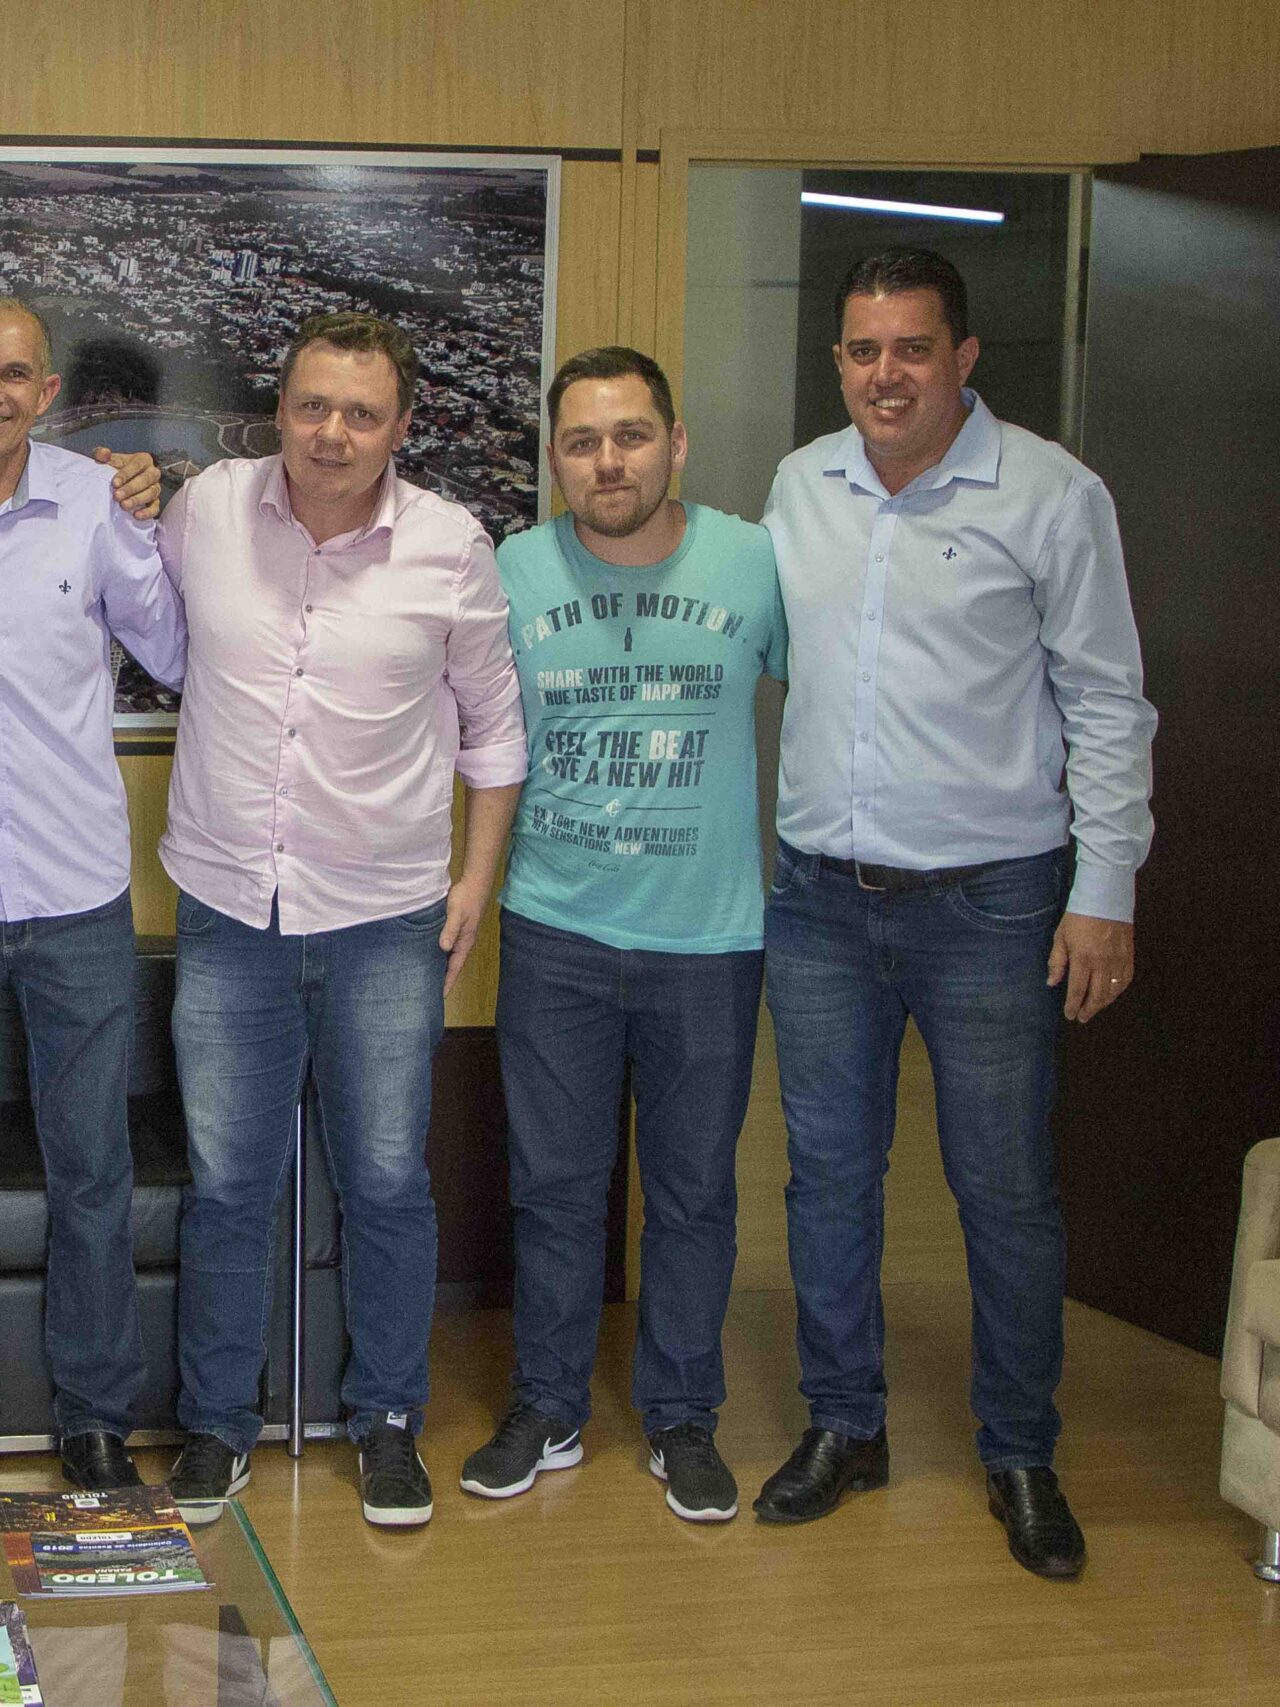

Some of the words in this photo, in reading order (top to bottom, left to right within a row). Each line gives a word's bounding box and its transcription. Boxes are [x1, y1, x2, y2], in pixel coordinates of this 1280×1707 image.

[519, 600, 583, 650] PATH
[591, 592, 624, 620] OF
[635, 592, 744, 639] MOTION
[536, 667, 584, 689] SHARE
[588, 665, 630, 685] WITH
[635, 664, 665, 683] THE
[669, 664, 724, 682] WORLD
[539, 690, 570, 706] TRUE
[574, 687, 616, 704] TASTE
[620, 685, 638, 701] OF
[641, 683, 722, 701] HAPPINESS
[597, 730, 643, 759] THE
[648, 729, 710, 760] BEAT
[584, 760, 599, 785] A
[606, 760, 662, 788] NEW
[667, 760, 705, 788] HIT
[533, 804, 577, 832] EXPLORE
[579, 821, 610, 839] NEW
[614, 826, 699, 842] ADVENTURES
[531, 818, 550, 833] NEW
[615, 842, 641, 856] NEW
[644, 843, 698, 857] MOMENTS
[62, 1491, 109, 1501] TOLEDO
[51, 1569, 179, 1583] TOLEDO
